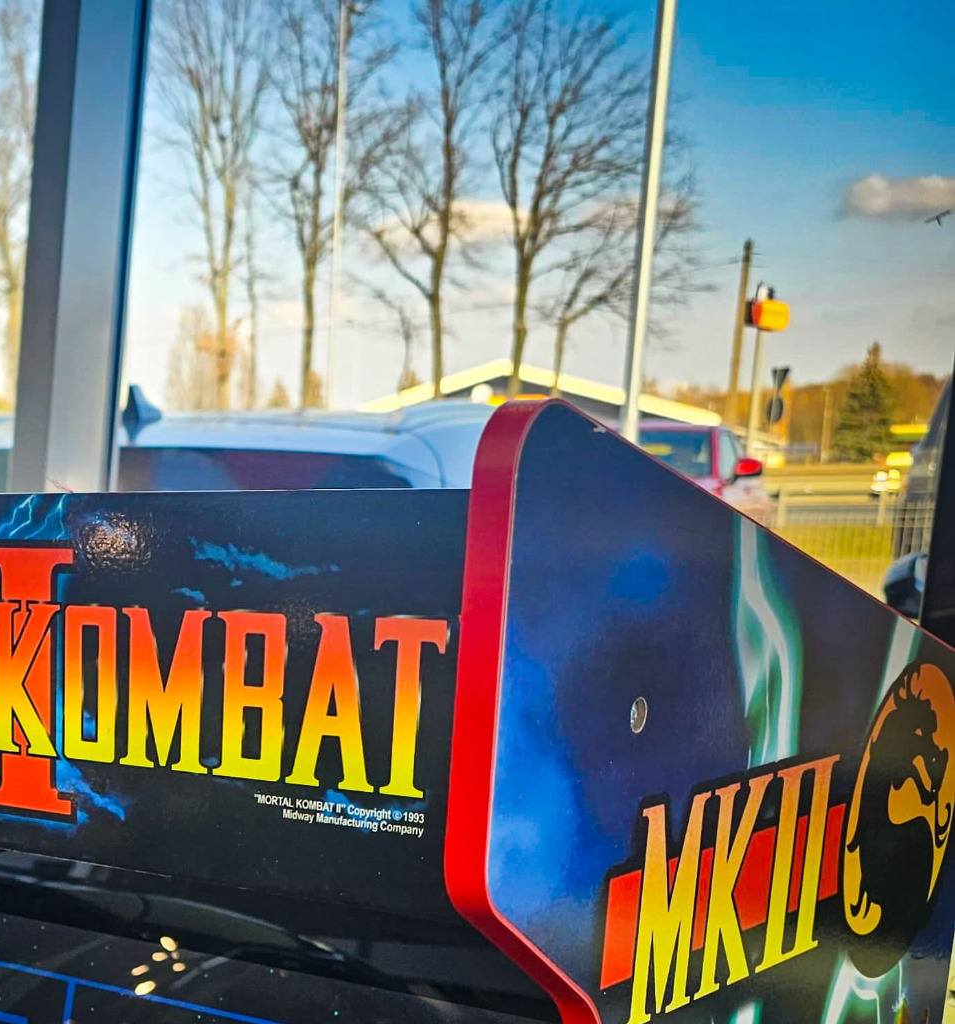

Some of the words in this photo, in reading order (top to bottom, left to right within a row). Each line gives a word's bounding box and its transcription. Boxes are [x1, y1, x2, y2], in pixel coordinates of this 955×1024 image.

[283, 809, 314, 823] Midway
[316, 813, 378, 832] Manufacturing
[380, 821, 424, 838] Company
[296, 798, 334, 812] KOMBAT
[348, 804, 391, 821] Copyright
[403, 812, 424, 824] 1993
